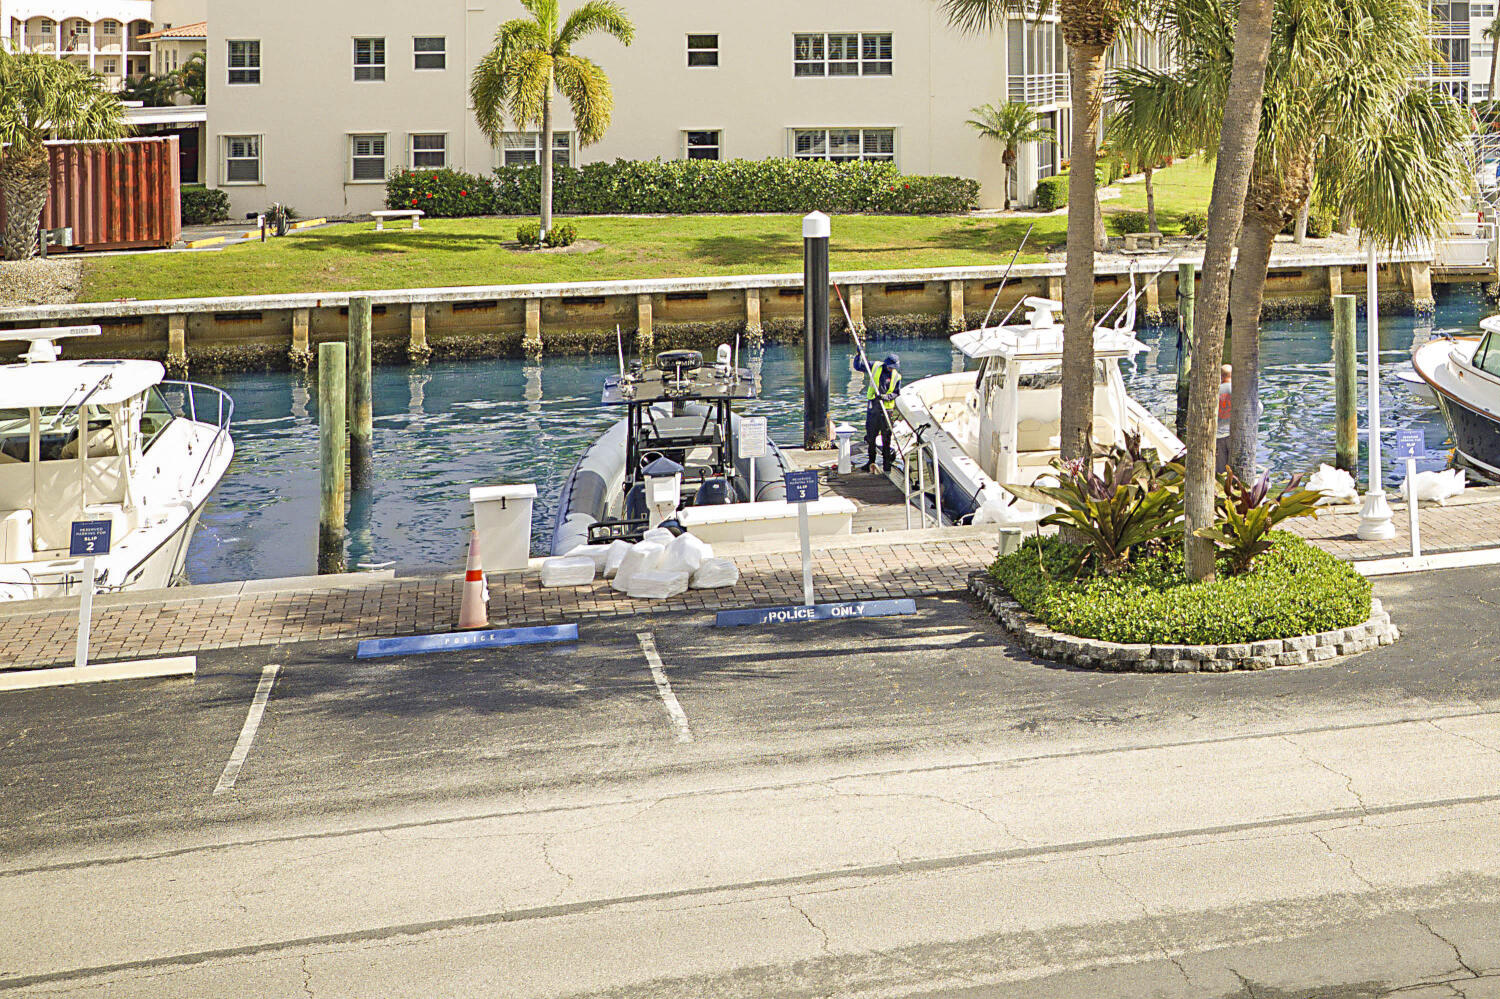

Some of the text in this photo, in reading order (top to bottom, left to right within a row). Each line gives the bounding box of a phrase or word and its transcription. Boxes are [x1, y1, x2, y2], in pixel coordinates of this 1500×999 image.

[799, 489, 806, 498] 3
[86, 541, 95, 551] 2
[769, 605, 864, 620] POLICE ONLY
[445, 633, 495, 645] POLICE
